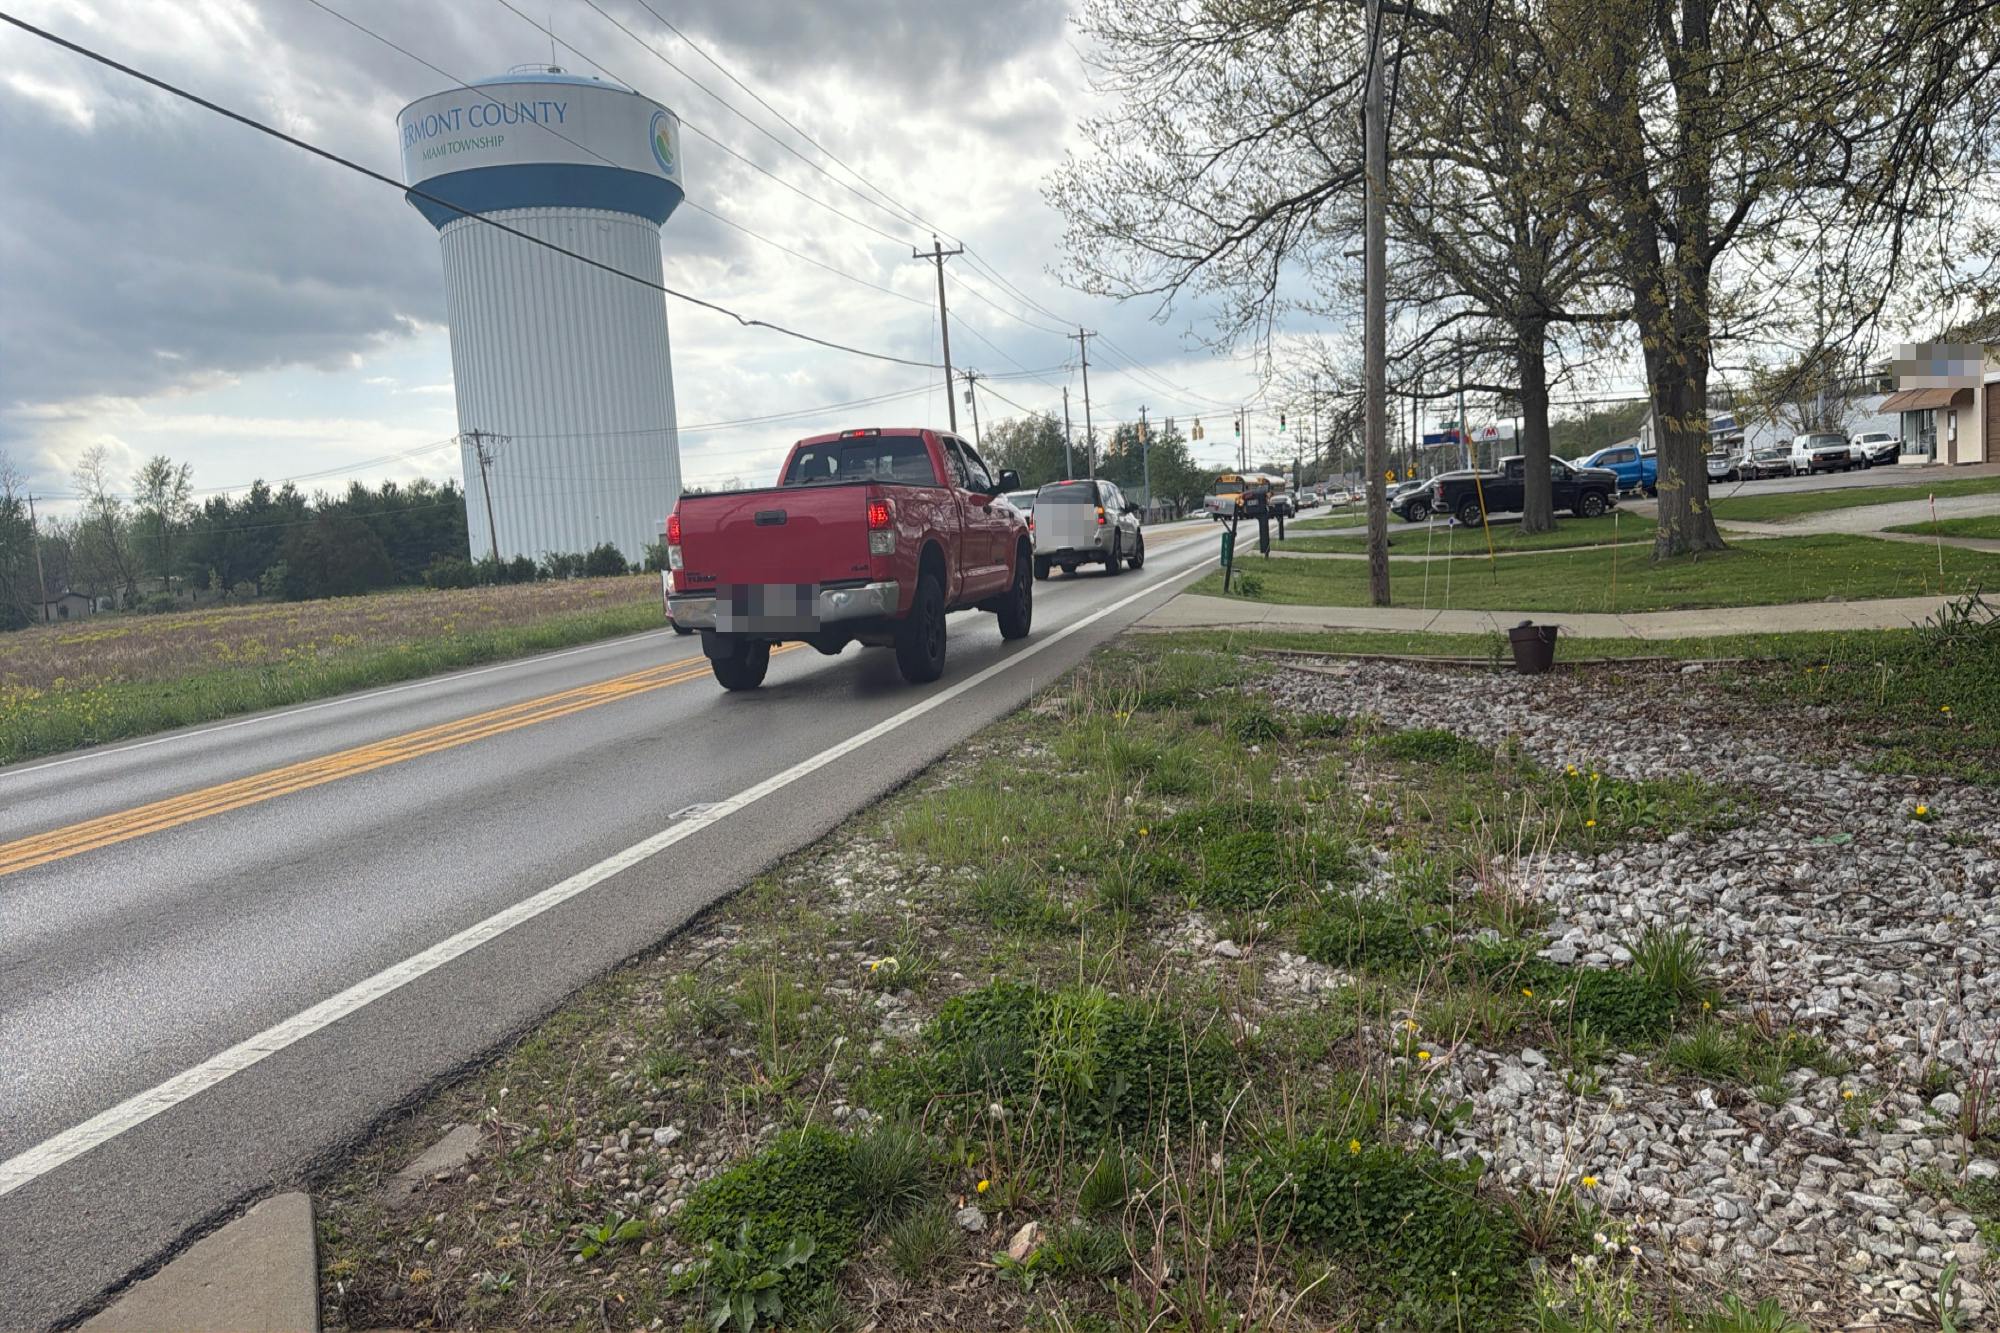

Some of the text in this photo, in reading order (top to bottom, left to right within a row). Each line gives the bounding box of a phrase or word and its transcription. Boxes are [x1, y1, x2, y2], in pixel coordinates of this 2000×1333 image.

[403, 101, 567, 151] ERMONT COUNTY
[422, 135, 504, 161] MIAMI TOWNSHIP
